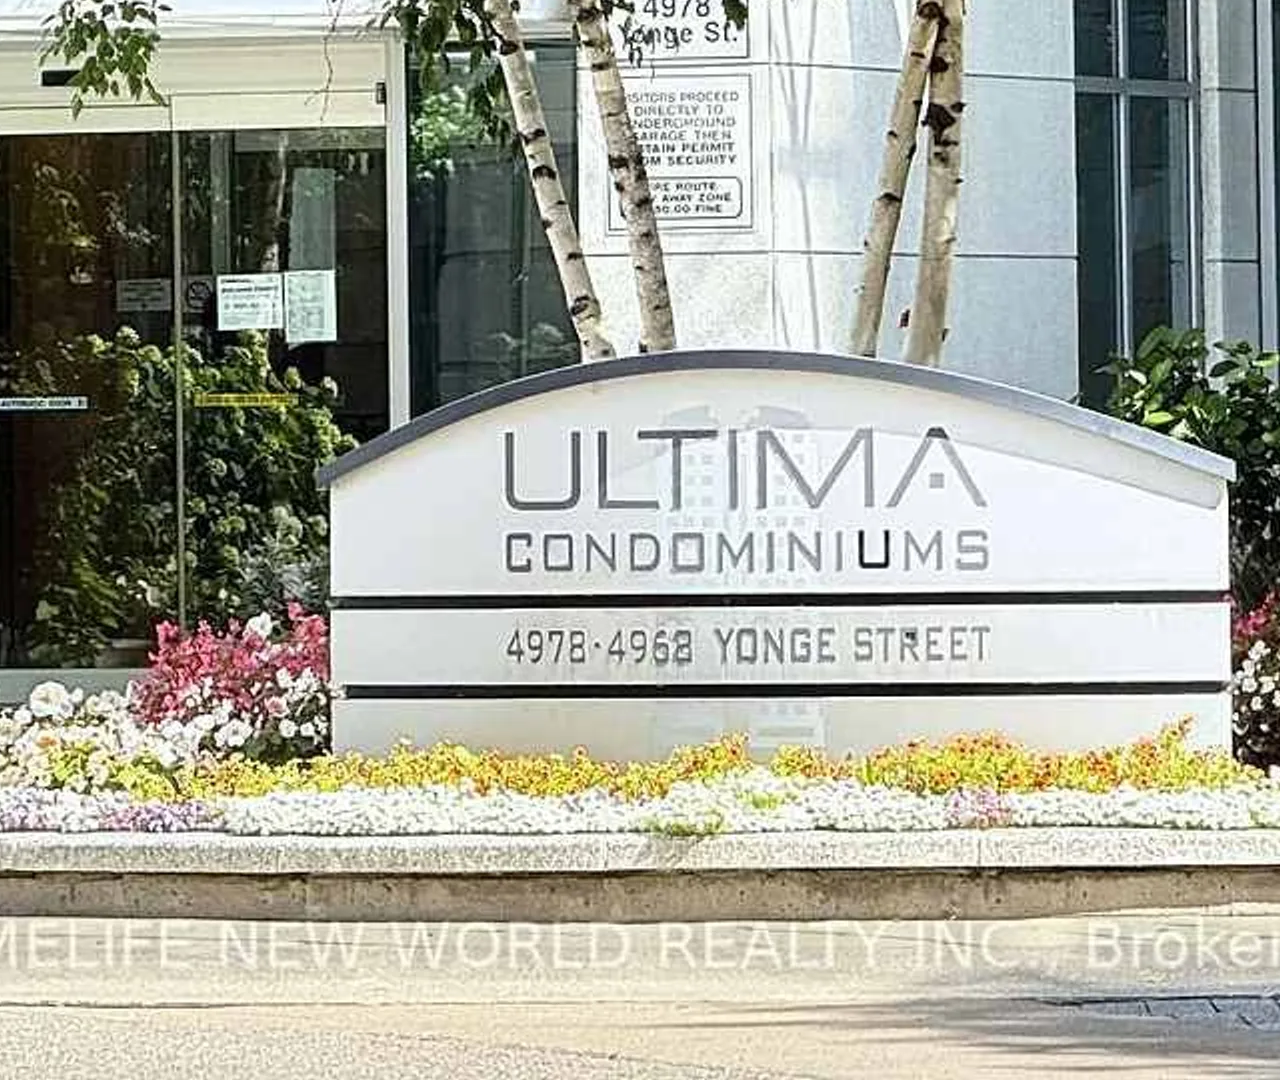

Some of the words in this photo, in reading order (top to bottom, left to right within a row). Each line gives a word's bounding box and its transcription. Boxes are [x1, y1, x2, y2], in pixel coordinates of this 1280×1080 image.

[618, 22, 693, 49] Yonge
[704, 21, 738, 43] St.
[634, 104, 699, 116] DIRECTLY
[706, 104, 723, 116] TO
[694, 129, 732, 140] THEN
[681, 142, 735, 154] PERMIT
[667, 155, 737, 166] SECURITY
[503, 427, 988, 511] ULTIMA
[505, 529, 989, 574] CONDOMINIUMS
[713, 626, 837, 664] YONGE
[853, 624, 991, 662] STREET
